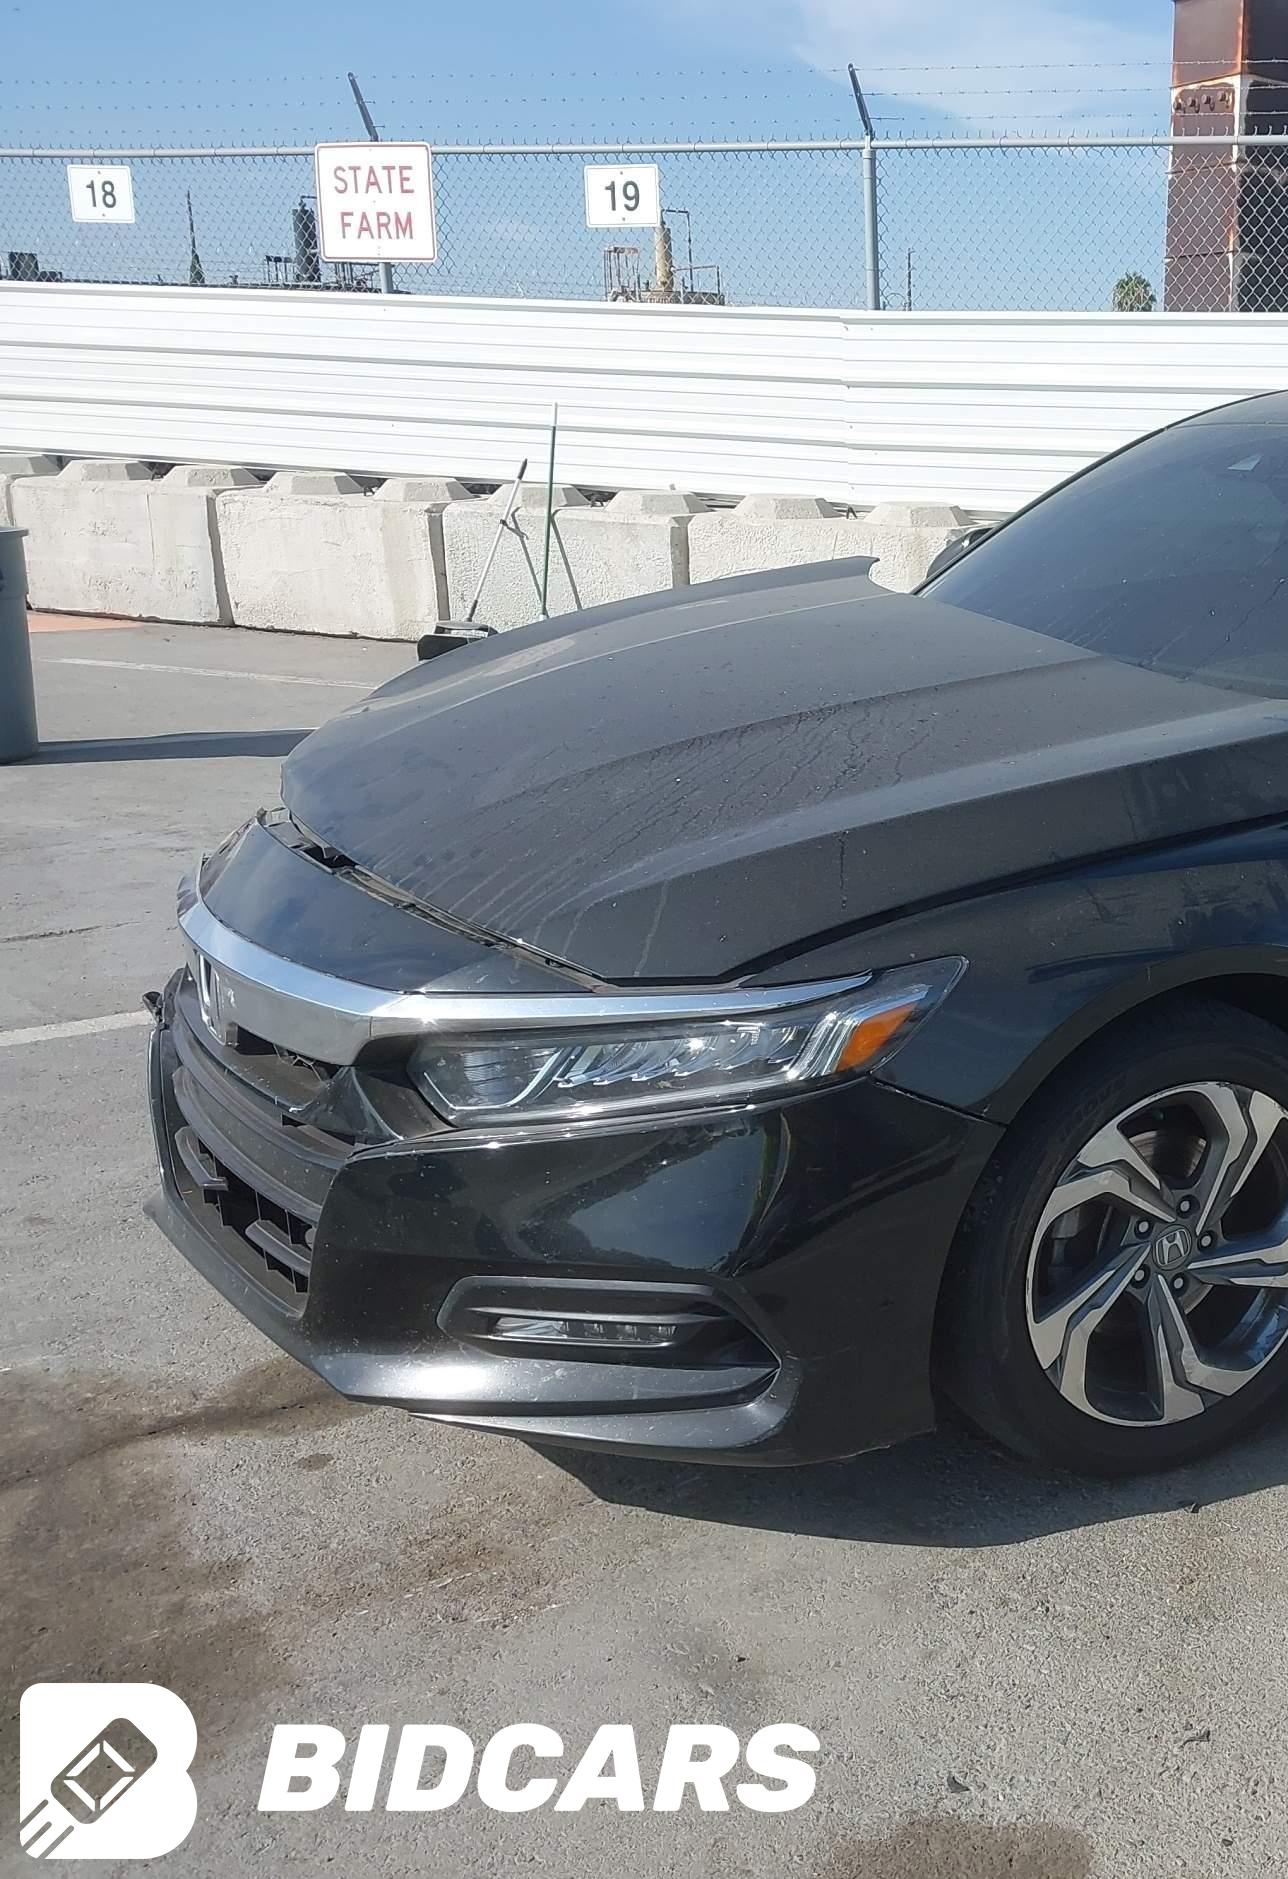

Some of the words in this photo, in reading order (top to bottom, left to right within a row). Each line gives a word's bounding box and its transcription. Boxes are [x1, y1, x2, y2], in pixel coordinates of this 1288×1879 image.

[333, 165, 415, 194] STATE
[86, 180, 117, 209] 18
[604, 180, 640, 212] 19
[340, 211, 413, 240] FARM
